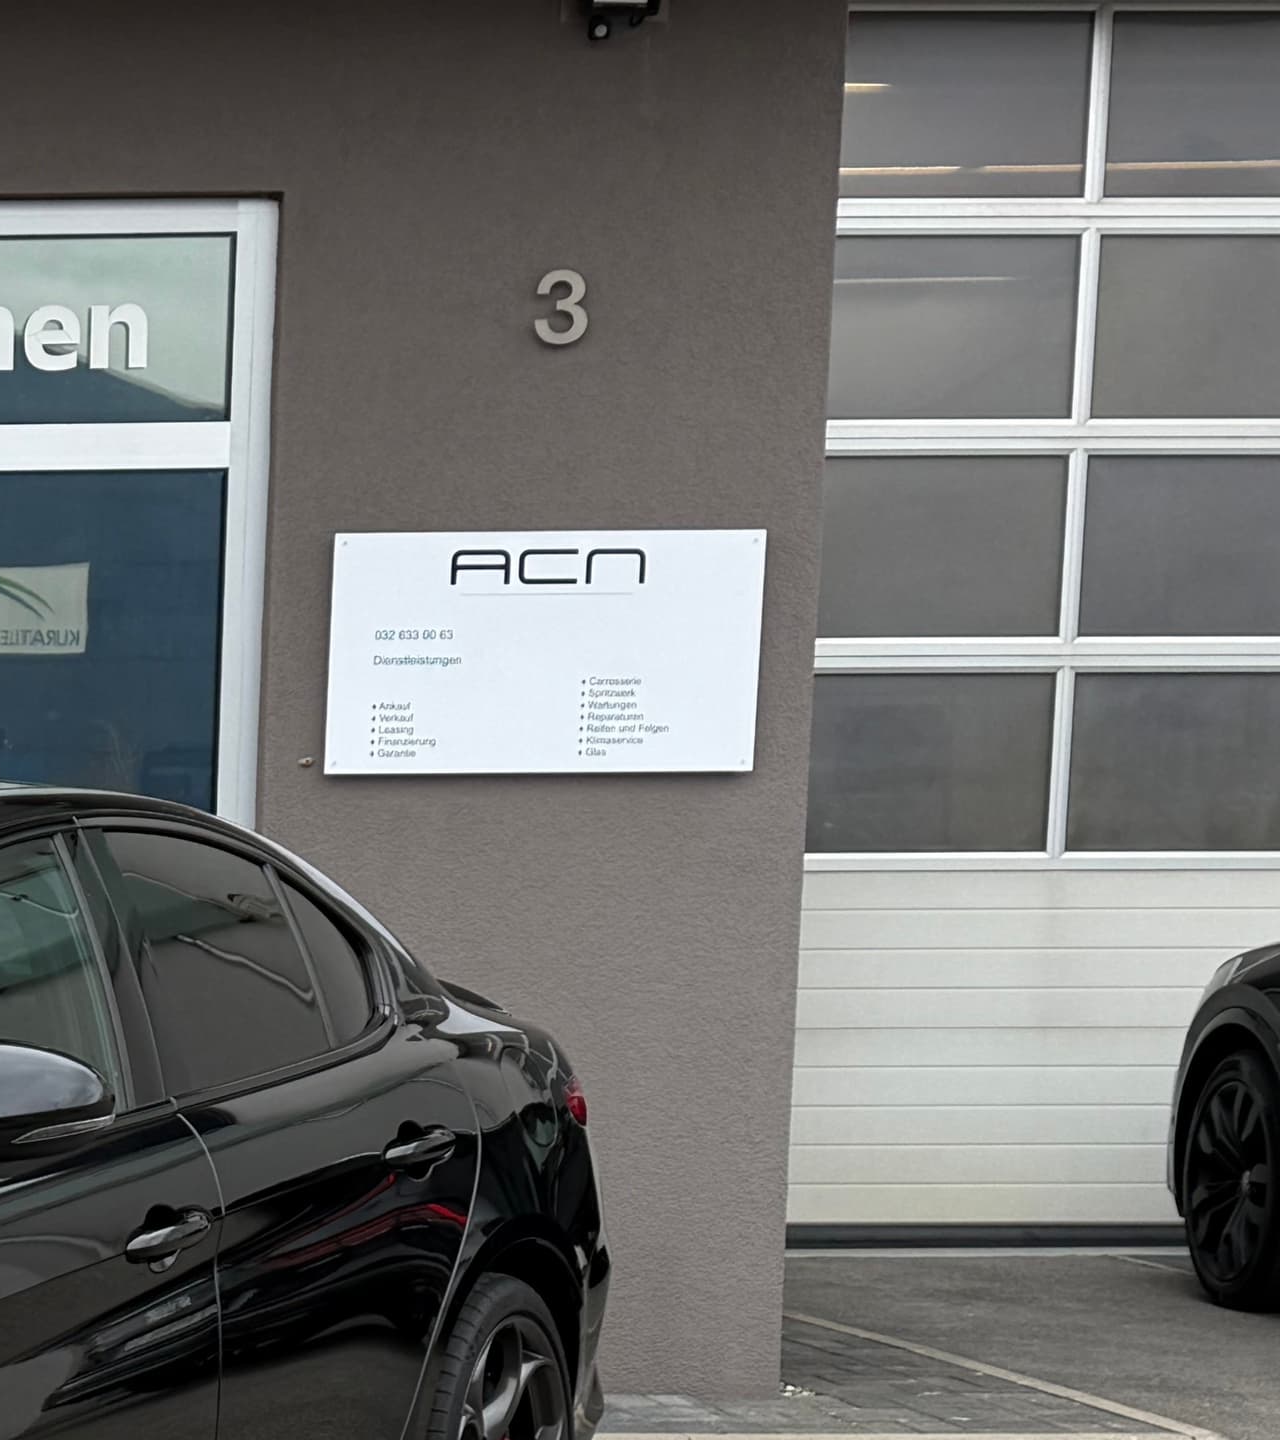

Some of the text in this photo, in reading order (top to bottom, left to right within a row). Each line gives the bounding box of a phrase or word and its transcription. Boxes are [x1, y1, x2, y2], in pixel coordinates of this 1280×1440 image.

[535, 269, 588, 345] 3
[374, 655, 461, 667] Dienstleistungen
[589, 677, 641, 685] Carrosserie
[379, 702, 411, 710] Ankauf
[588, 701, 637, 711] Wartungen
[379, 713, 413, 722] Verkauf
[587, 712, 644, 722] Reparaturen
[379, 726, 414, 735] Leasing
[587, 724, 669, 734] Reifen und Folgen
[378, 737, 436, 747] Finanzierung
[586, 736, 643, 744] Klimaservice
[377, 749, 416, 758] Garantie
[586, 748, 606, 756] Glas
